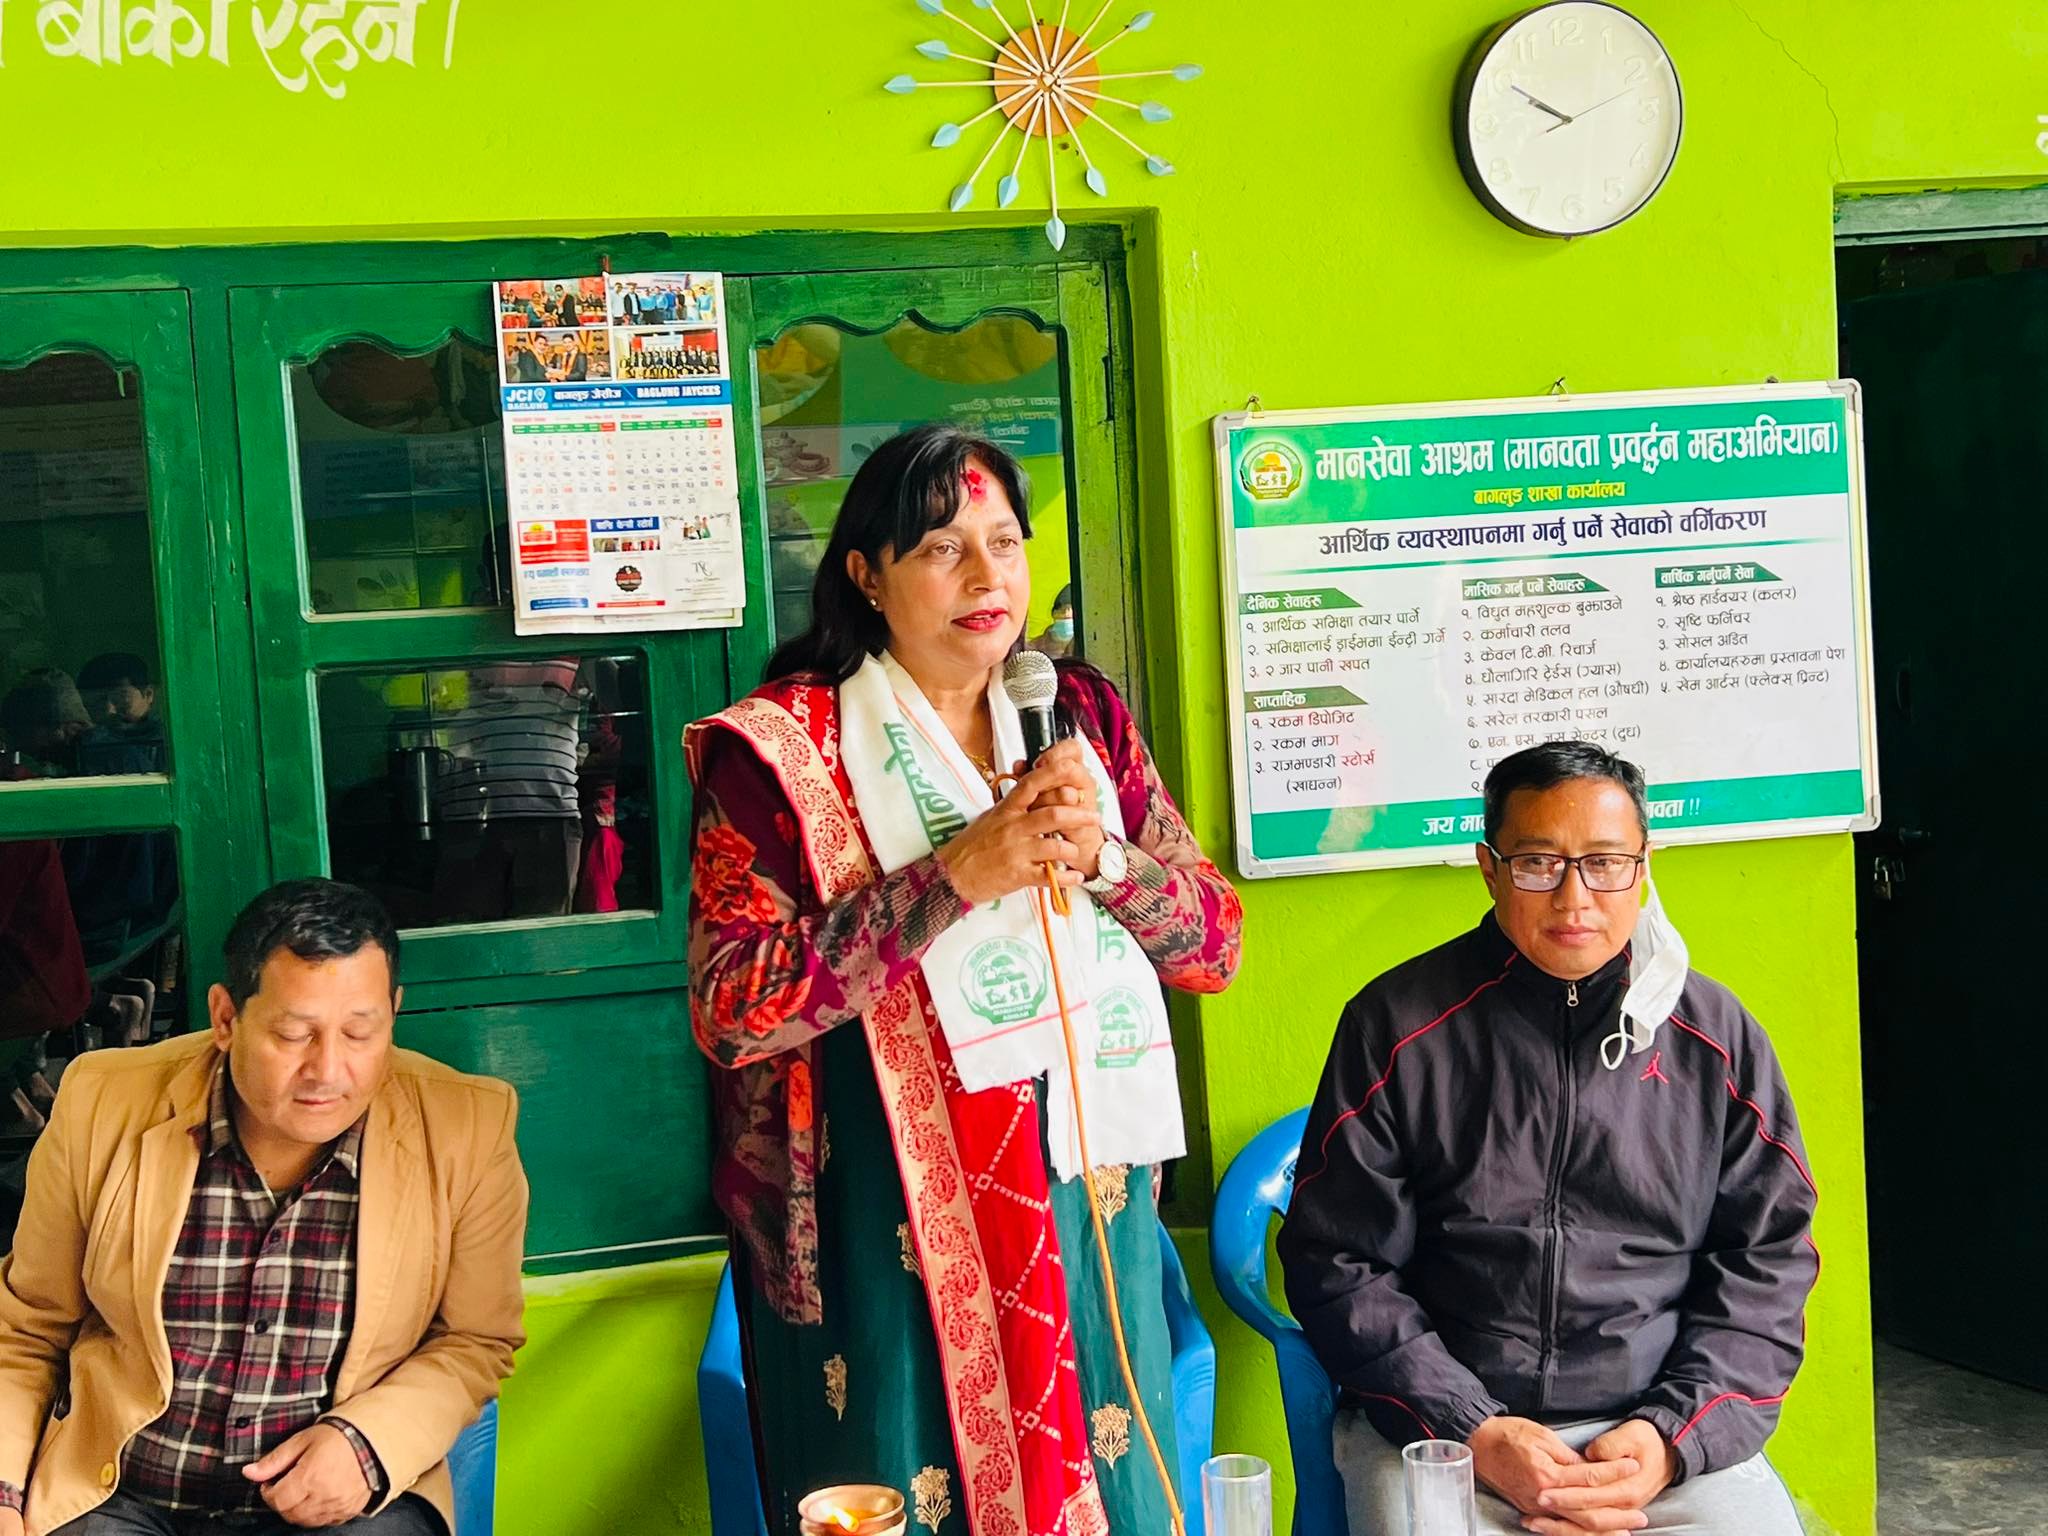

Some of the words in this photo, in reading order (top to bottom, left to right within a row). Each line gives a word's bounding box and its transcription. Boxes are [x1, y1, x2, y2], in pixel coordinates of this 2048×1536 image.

[1549, 16, 1585, 47] 12
[1601, 25, 1615, 56] 1
[1513, 32, 1538, 64] 11
[1624, 56, 1648, 87] 2
[1520, 186, 1540, 216] 7
[506, 389, 533, 402] JCI
[1315, 435, 1413, 481] मानसेवा
[1420, 439, 1495, 477] आश्रम
[1503, 435, 1602, 472] (मानवता
[1687, 414, 1839, 463] महाअभियान)
[1474, 487, 1523, 508] बागलुङ
[1528, 484, 1562, 502] शाखा
[1567, 480, 1626, 499] कार्यालय
[1319, 527, 1390, 555] आर्थिक
[1397, 523, 1526, 550] व्यवस्थापनमा
[1532, 517, 1567, 546] गर्नु
[1573, 513, 1604, 540] पर्ने
[1611, 510, 1673, 539] सेवाको
[1734, 564, 1755, 580] सेवा
[1464, 582, 1501, 597] मासिक
[1752, 586, 1797, 603] (कलर)
[1246, 593, 1280, 611] दैनिक
[1263, 614, 1306, 633] आर्थिक
[1359, 611, 1392, 626] तयार
[1279, 662, 1302, 676] जार
[1307, 658, 1334, 673] पानी
[1524, 686, 1574, 703] मेडिकल
[1578, 687, 1599, 700] हल
[1269, 715, 1303, 729] रकम
[1308, 710, 1355, 726] डिपोजिट
[1523, 707, 1572, 723] तरकारी
[1576, 707, 1608, 720] पसल
[1270, 737, 1306, 750] रकम
[1311, 735, 1341, 747] माग
[1422, 816, 1456, 836] जय
